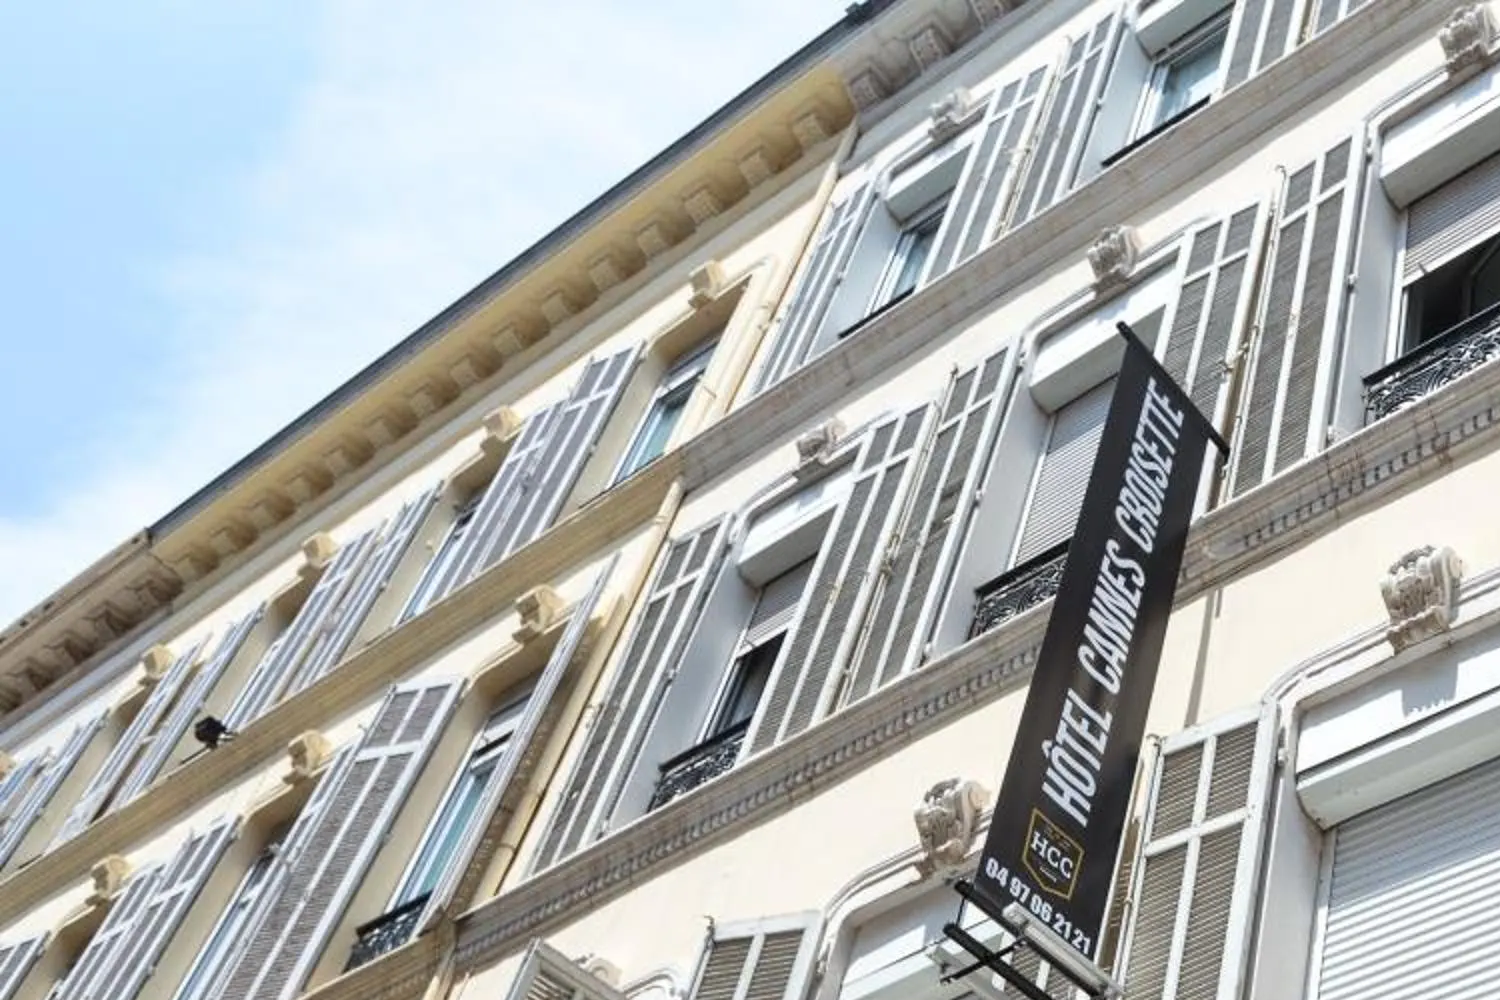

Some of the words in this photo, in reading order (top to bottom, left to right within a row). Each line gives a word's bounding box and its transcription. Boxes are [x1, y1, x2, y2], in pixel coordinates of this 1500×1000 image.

[1041, 687, 1112, 828] HÔTEL
[1078, 538, 1146, 696] CANNES
[1115, 377, 1185, 554] CROISETTE
[1031, 831, 1073, 879] HCC
[985, 857, 1009, 888] 04
[1053, 913, 1073, 940] 21
[1072, 928, 1092, 955] 21
